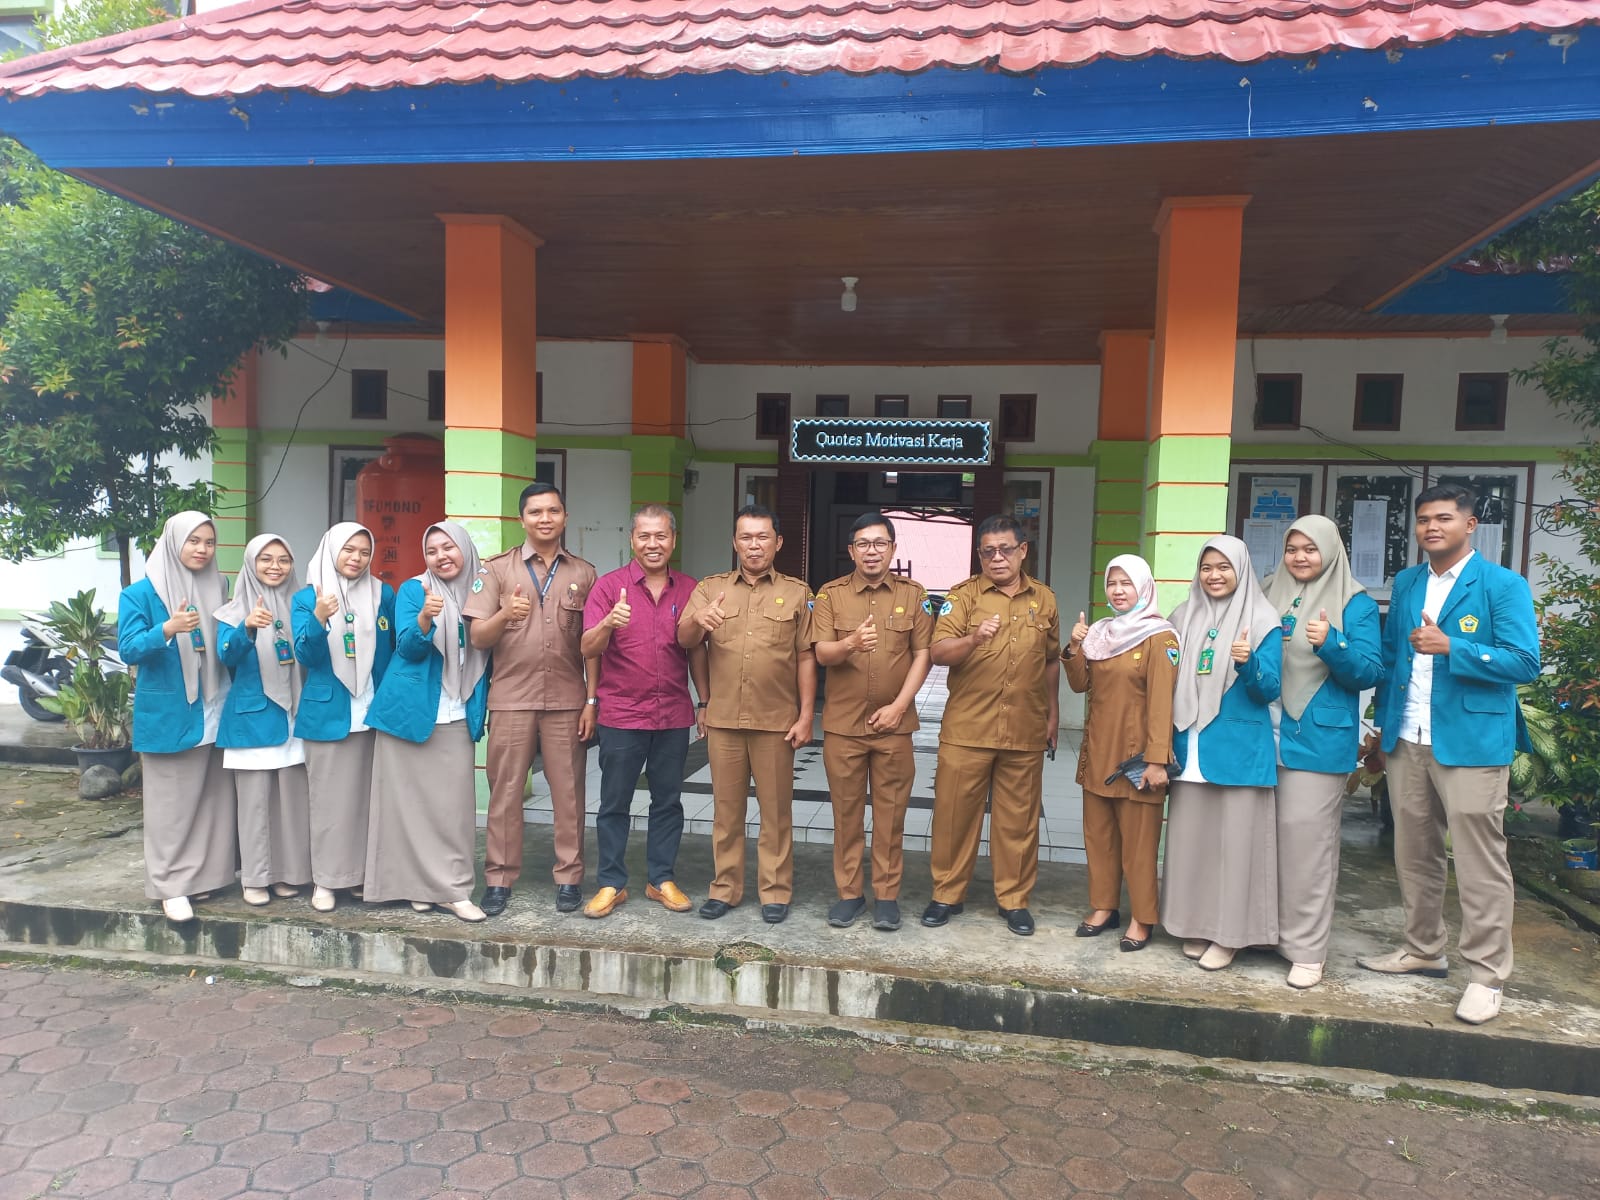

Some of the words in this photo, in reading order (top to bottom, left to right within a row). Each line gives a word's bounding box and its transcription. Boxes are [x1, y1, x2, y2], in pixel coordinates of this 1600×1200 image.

[815, 431, 862, 447] Quotes
[866, 432, 925, 448] Motivasi
[928, 433, 963, 450] Kerja
